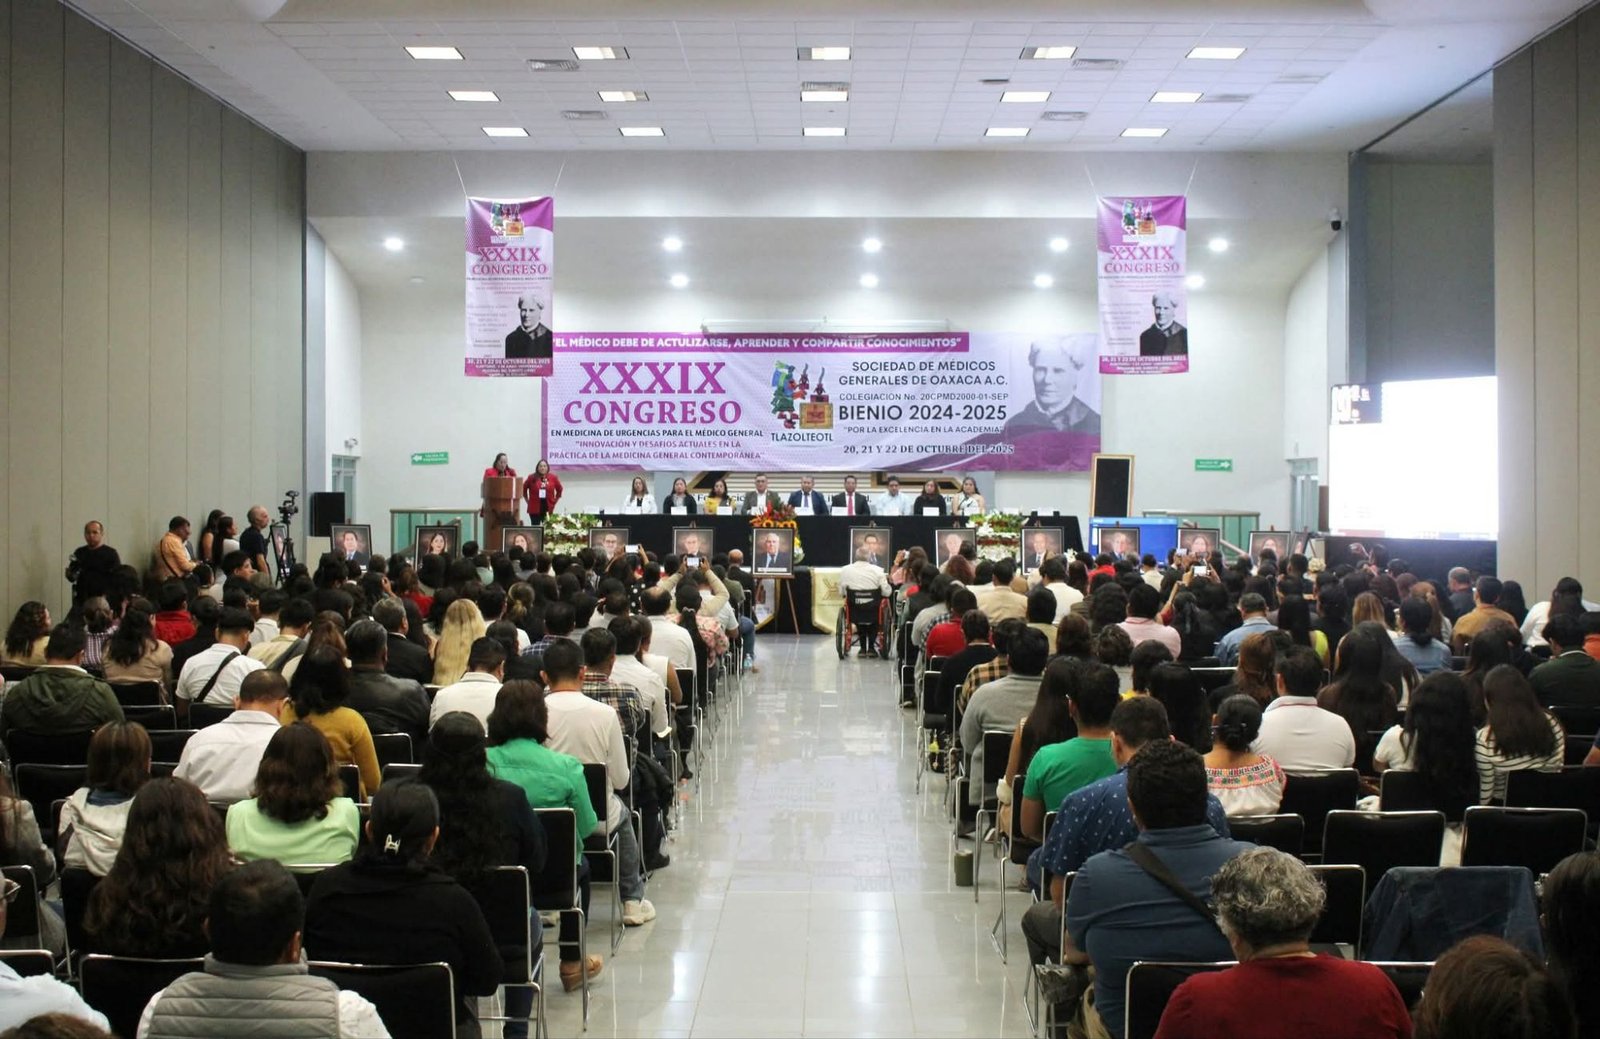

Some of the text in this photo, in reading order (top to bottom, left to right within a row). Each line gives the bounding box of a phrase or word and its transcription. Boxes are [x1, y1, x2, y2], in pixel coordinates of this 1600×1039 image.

[478, 247, 541, 262] XXXIX
[1111, 246, 1174, 260] XXXIX
[472, 264, 547, 276] CONGRESO
[1104, 262, 1180, 274] CONGRESO
[569, 336, 610, 347] MÉDICO
[612, 338, 639, 347] DEBE
[641, 338, 654, 347] DE
[656, 338, 731, 348] ACTULIZARSE,
[734, 338, 790, 347] APRENDER
[792, 338, 800, 347] Y
[802, 338, 865, 347] COMPARTIR
[852, 359, 995, 371] SOCIEDAD DE MÉDICOS
[579, 362, 726, 394] XXXIX
[839, 376, 1008, 385] GENERALES DE OAXACA A.C.
[563, 400, 742, 424] CONGRESO
[839, 405, 1007, 420] BIENIO 2024-2025
[695, 428, 726, 436] MÉDICO
[771, 433, 833, 441] TLAZOLTEOTL
[844, 445, 1014, 454] 20, 21 Y 22 DE OCTUBRE DEL 2025
